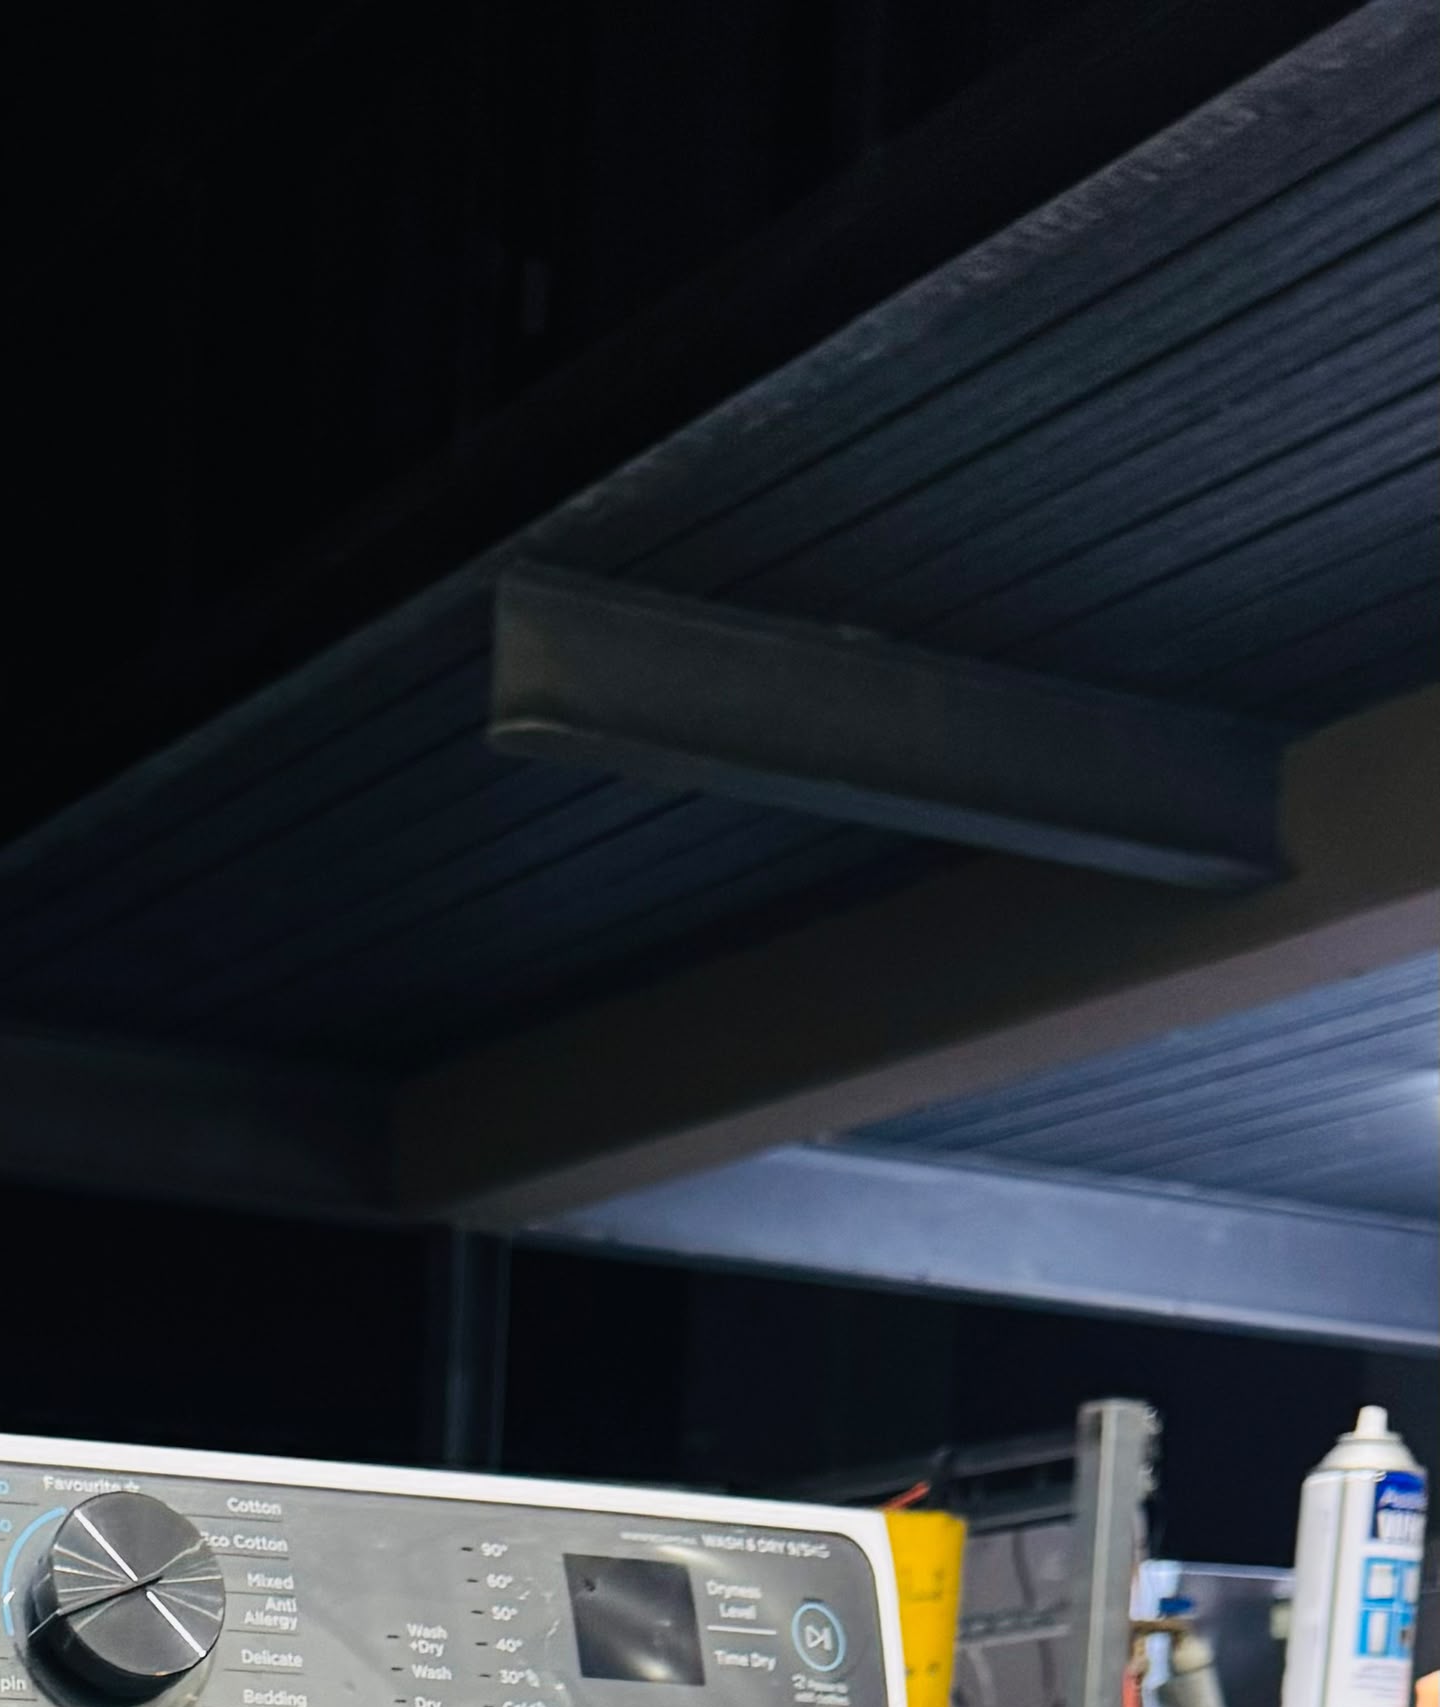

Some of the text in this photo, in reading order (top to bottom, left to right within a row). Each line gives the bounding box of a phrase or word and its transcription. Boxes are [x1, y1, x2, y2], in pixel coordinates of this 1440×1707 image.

[227, 1496, 282, 1515] Cotton
[233, 1533, 288, 1551] Cotton
[247, 1572, 294, 1589] Mixed
[265, 1596, 297, 1612] Anti
[244, 1610, 298, 1631] Allergy
[406, 1623, 448, 1640] Wash
[241, 1648, 304, 1668] Delicate
[411, 1663, 453, 1681] Wash
